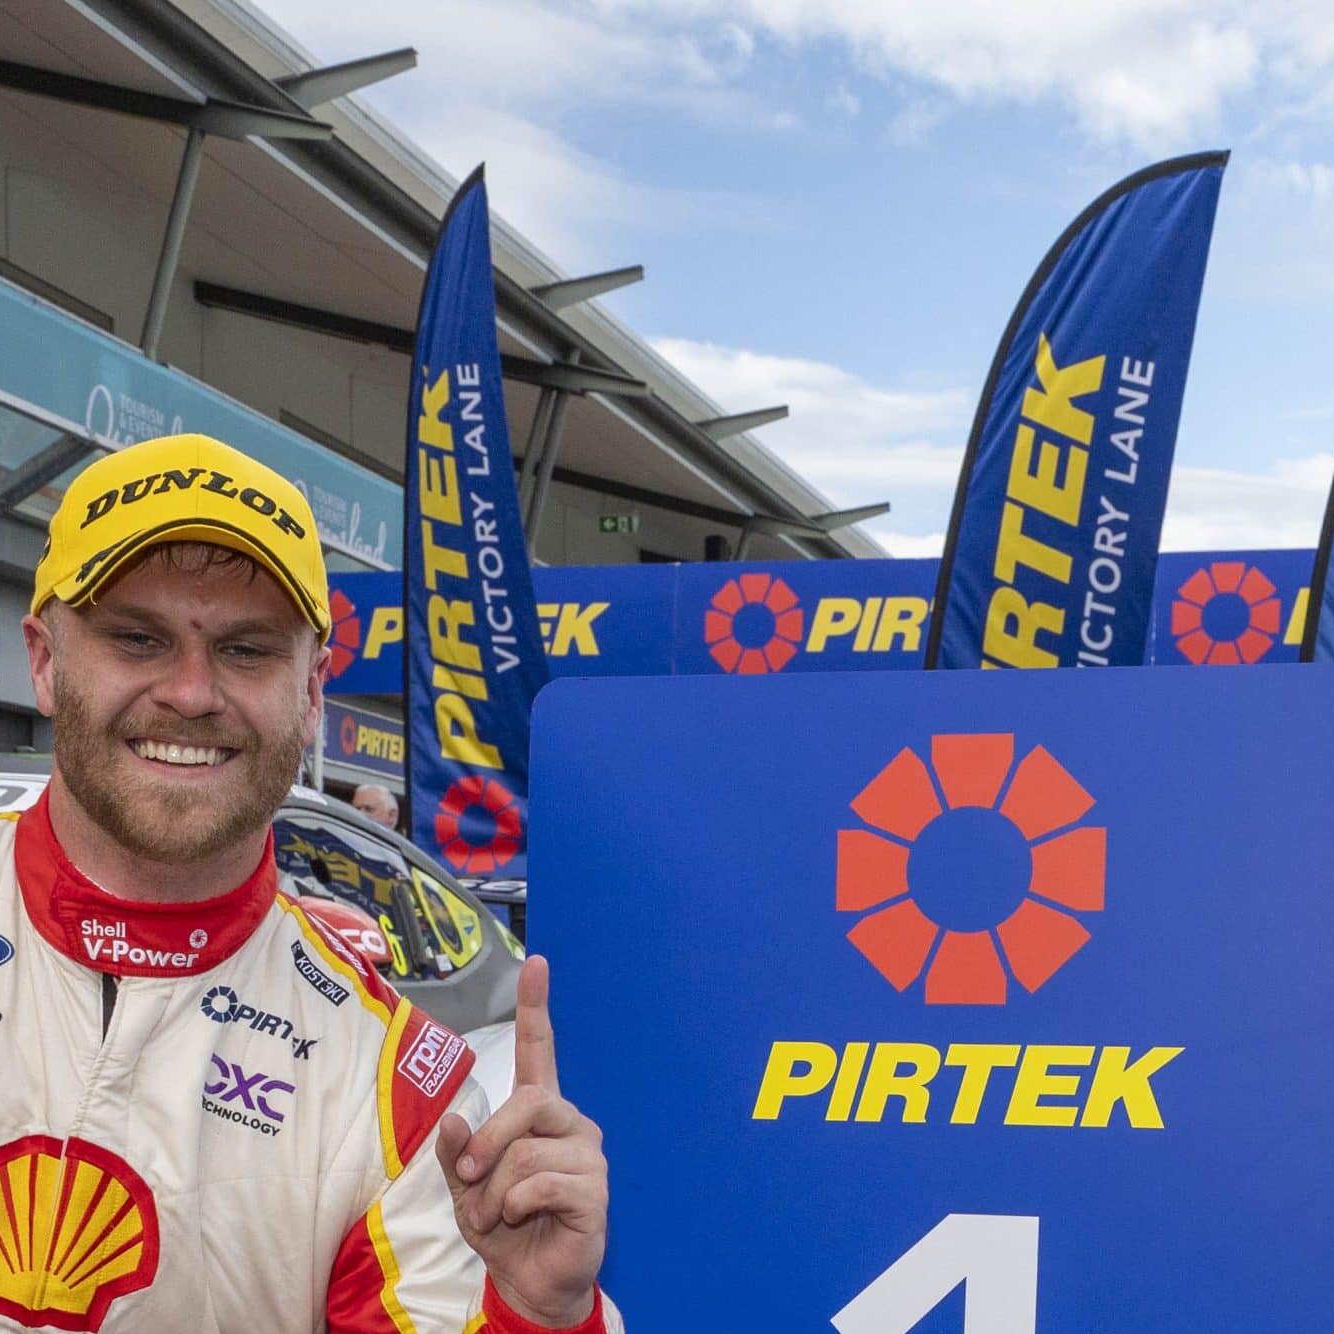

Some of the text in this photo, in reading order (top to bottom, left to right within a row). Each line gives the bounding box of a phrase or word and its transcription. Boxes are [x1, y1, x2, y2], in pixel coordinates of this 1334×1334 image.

[80, 468, 306, 540] DUNLOP
[456, 362, 521, 673] VICTORY LANE
[980, 331, 1107, 670] RTEK
[1077, 355, 1156, 668] ICTORY LANE
[419, 366, 505, 770] PIRTEK
[81, 919, 127, 939] Shell
[82, 938, 199, 969] V-Power
[295, 955, 348, 1004] KOST3KI
[424, 1036, 465, 1094] RACEWEAR
[752, 1041, 1185, 1129] PIRTEK
